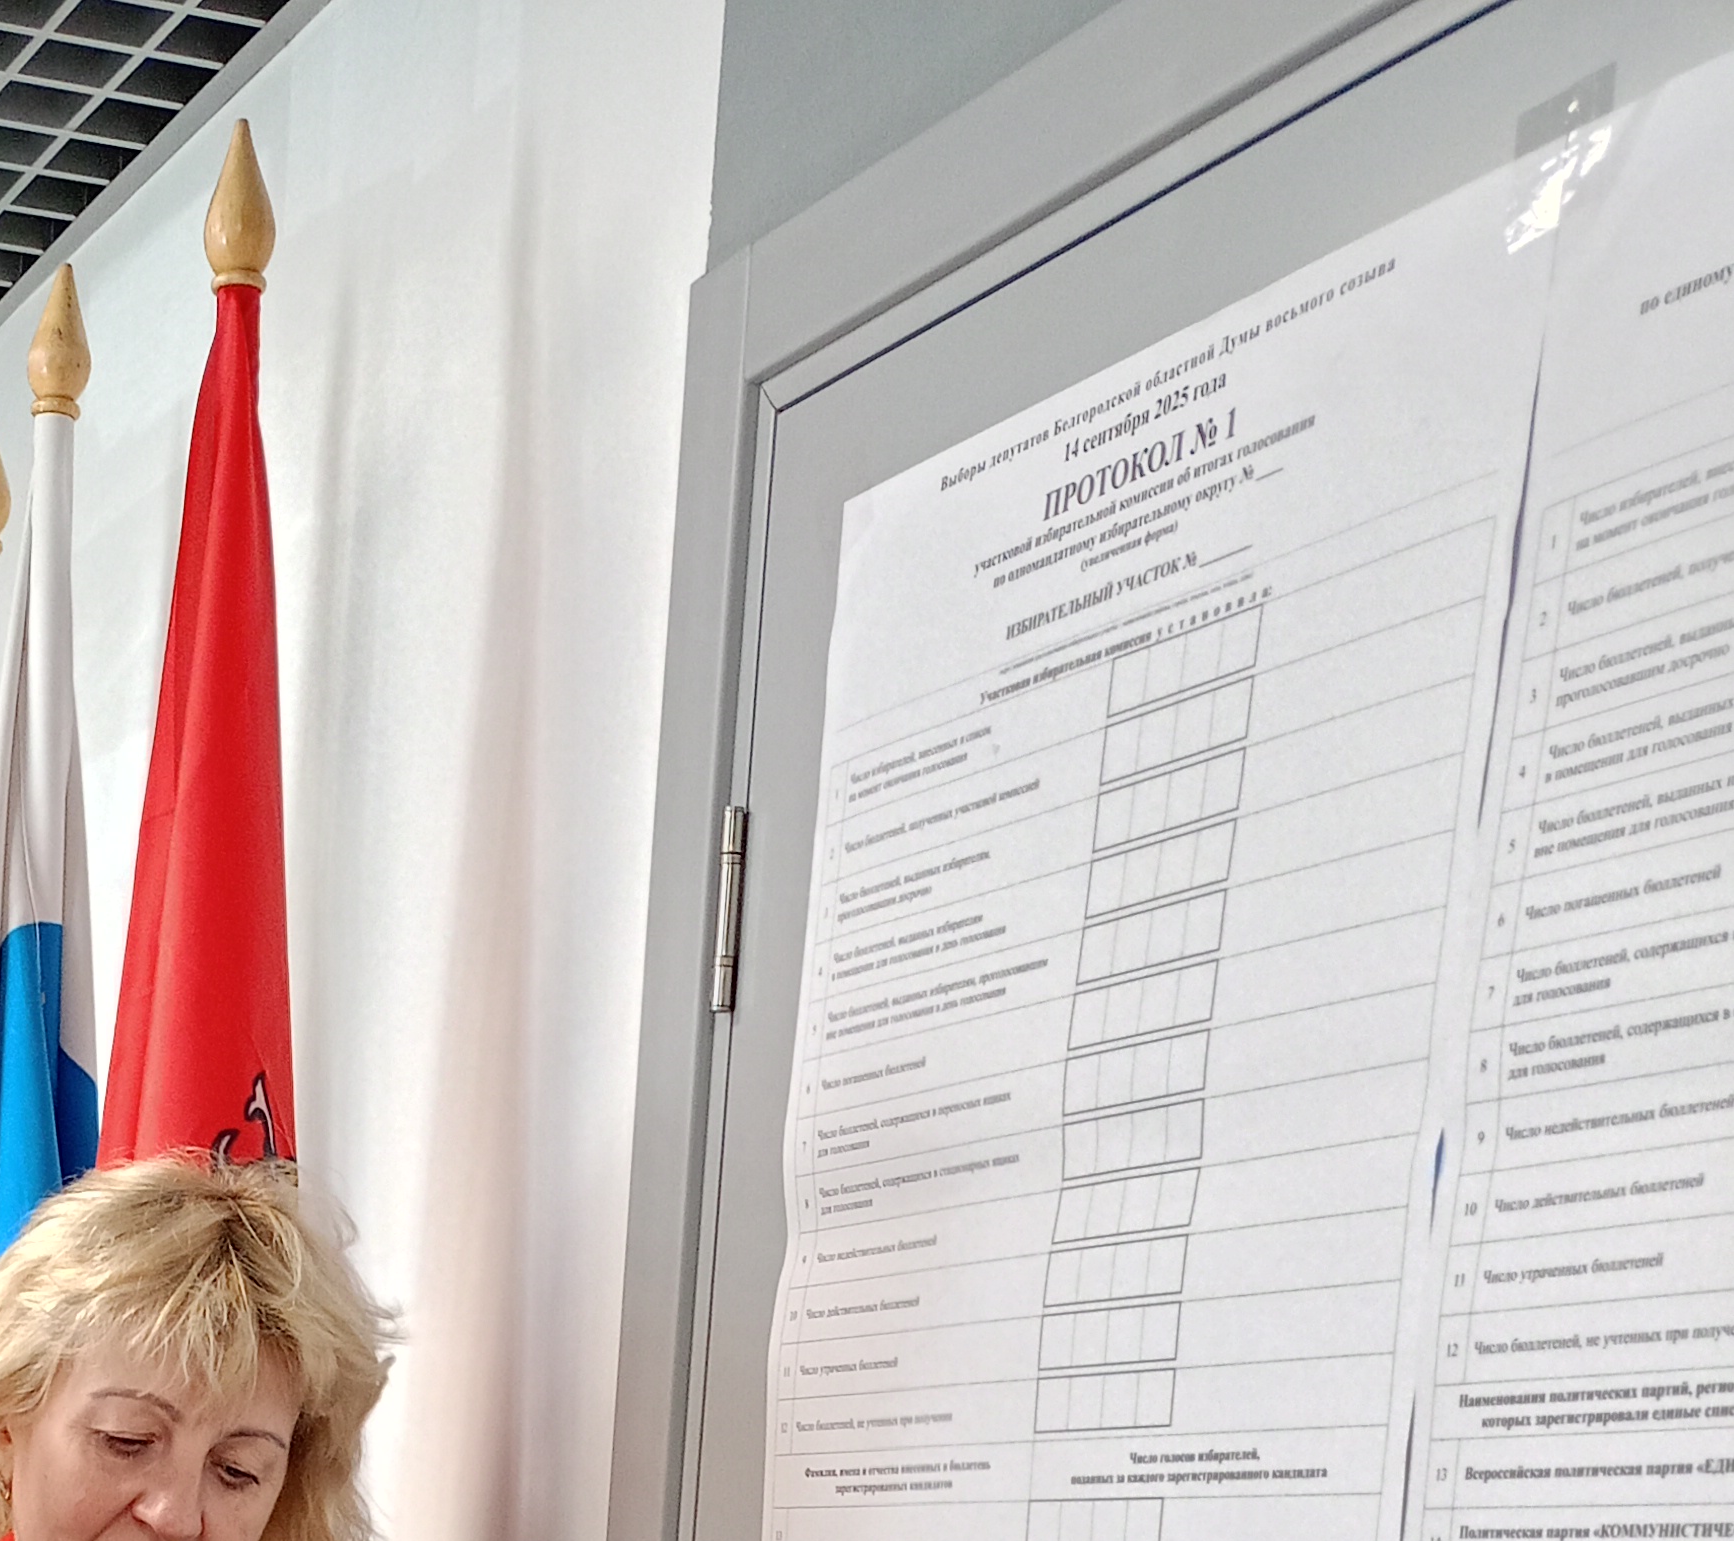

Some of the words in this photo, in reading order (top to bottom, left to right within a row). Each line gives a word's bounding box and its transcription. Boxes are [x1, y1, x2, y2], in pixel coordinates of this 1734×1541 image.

[1639, 296, 1660, 316] по
[1663, 263, 1734, 305] единому
[940, 460, 987, 492] Выборы
[989, 429, 1050, 468] депутатов
[1053, 382, 1141, 437] Белгородской
[1145, 343, 1215, 391] областной
[1218, 324, 1261, 357] Думы
[1265, 288, 1335, 333] восьмого
[1339, 258, 1396, 296] созыва
[1065, 437, 1080, 462] 14
[1082, 409, 1150, 453] сентября
[1153, 390, 1189, 420] 2025
[1193, 373, 1227, 402] года
[1043, 430, 1185, 522] ПРОТОКОЛ
[1189, 422, 1218, 455] №
[1227, 407, 1236, 439] 1
[974, 536, 1033, 574] участковой
[1034, 500, 1117, 548] избирательной
[1119, 478, 1175, 512] комиссии
[1176, 466, 1191, 486] об
[1193, 452, 1234, 479] итогах
[1236, 414, 1316, 460] голосования
[993, 574, 1006, 589] по
[1007, 536, 1095, 582] одномандатному
[1099, 495, 1191, 544] избирательному
[1195, 476, 1235, 503] округу
[1006, 581, 1114, 641] ИЗБИРАТЕЛЬНЫЙ
[1116, 556, 1182, 596] УЧАСТОК
[1497, 915, 1505, 927] 6
[1479, 1058, 1488, 1073] 8
[1477, 1131, 1485, 1145] 9
[1464, 1202, 1477, 1217] 10
[1454, 1273, 1466, 1287] 11
[1446, 1343, 1459, 1358] 12
[1459, 1392, 1546, 1408] Наименования
[1549, 1387, 1638, 1403] политических
[1641, 1381, 1693, 1401] партий,
[1481, 1415, 1532, 1431] которых
[1535, 1410, 1650, 1429] зарегистрировали
[1651, 1407, 1702, 1421] единые
[1435, 1467, 1448, 1482] 13
[1464, 1465, 1552, 1484] Всероссийская
[1554, 1464, 1643, 1478] политическая
[1646, 1463, 1694, 1479] партия
[1459, 1525, 1543, 1539] Политическая
[1546, 1527, 1591, 1541] партия
